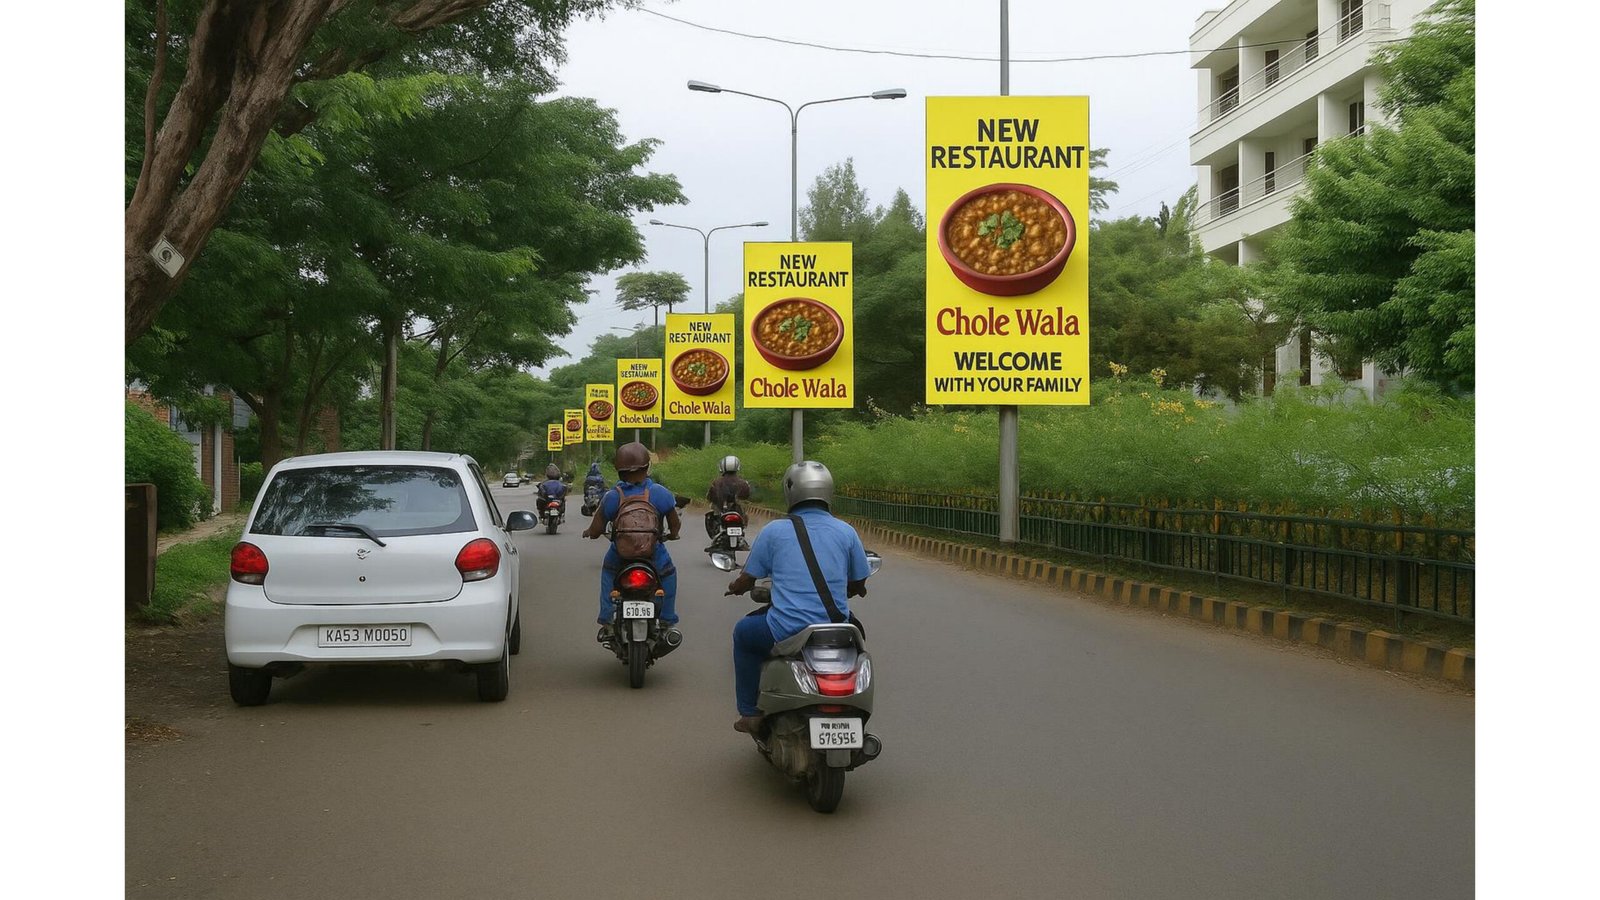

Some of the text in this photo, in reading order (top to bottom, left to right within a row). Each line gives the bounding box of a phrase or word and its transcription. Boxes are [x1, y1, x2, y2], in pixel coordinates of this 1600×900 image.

[977, 118, 1039, 143] NEW
[931, 145, 1085, 169] RESTAURANT
[780, 254, 817, 270] NEW
[748, 271, 849, 288] RESTAURANT
[689, 321, 712, 332] NEW
[936, 306, 1080, 337] Chole Wala
[669, 332, 731, 343] RESTAURANT
[954, 351, 1062, 372] WELCOME
[750, 376, 847, 398] Chole Wala
[934, 377, 1083, 393] WITH YOUR FAMILY
[669, 401, 731, 415] Chole Wala
[619, 413, 642, 424] Chole
[326, 628, 360, 642] KA53
